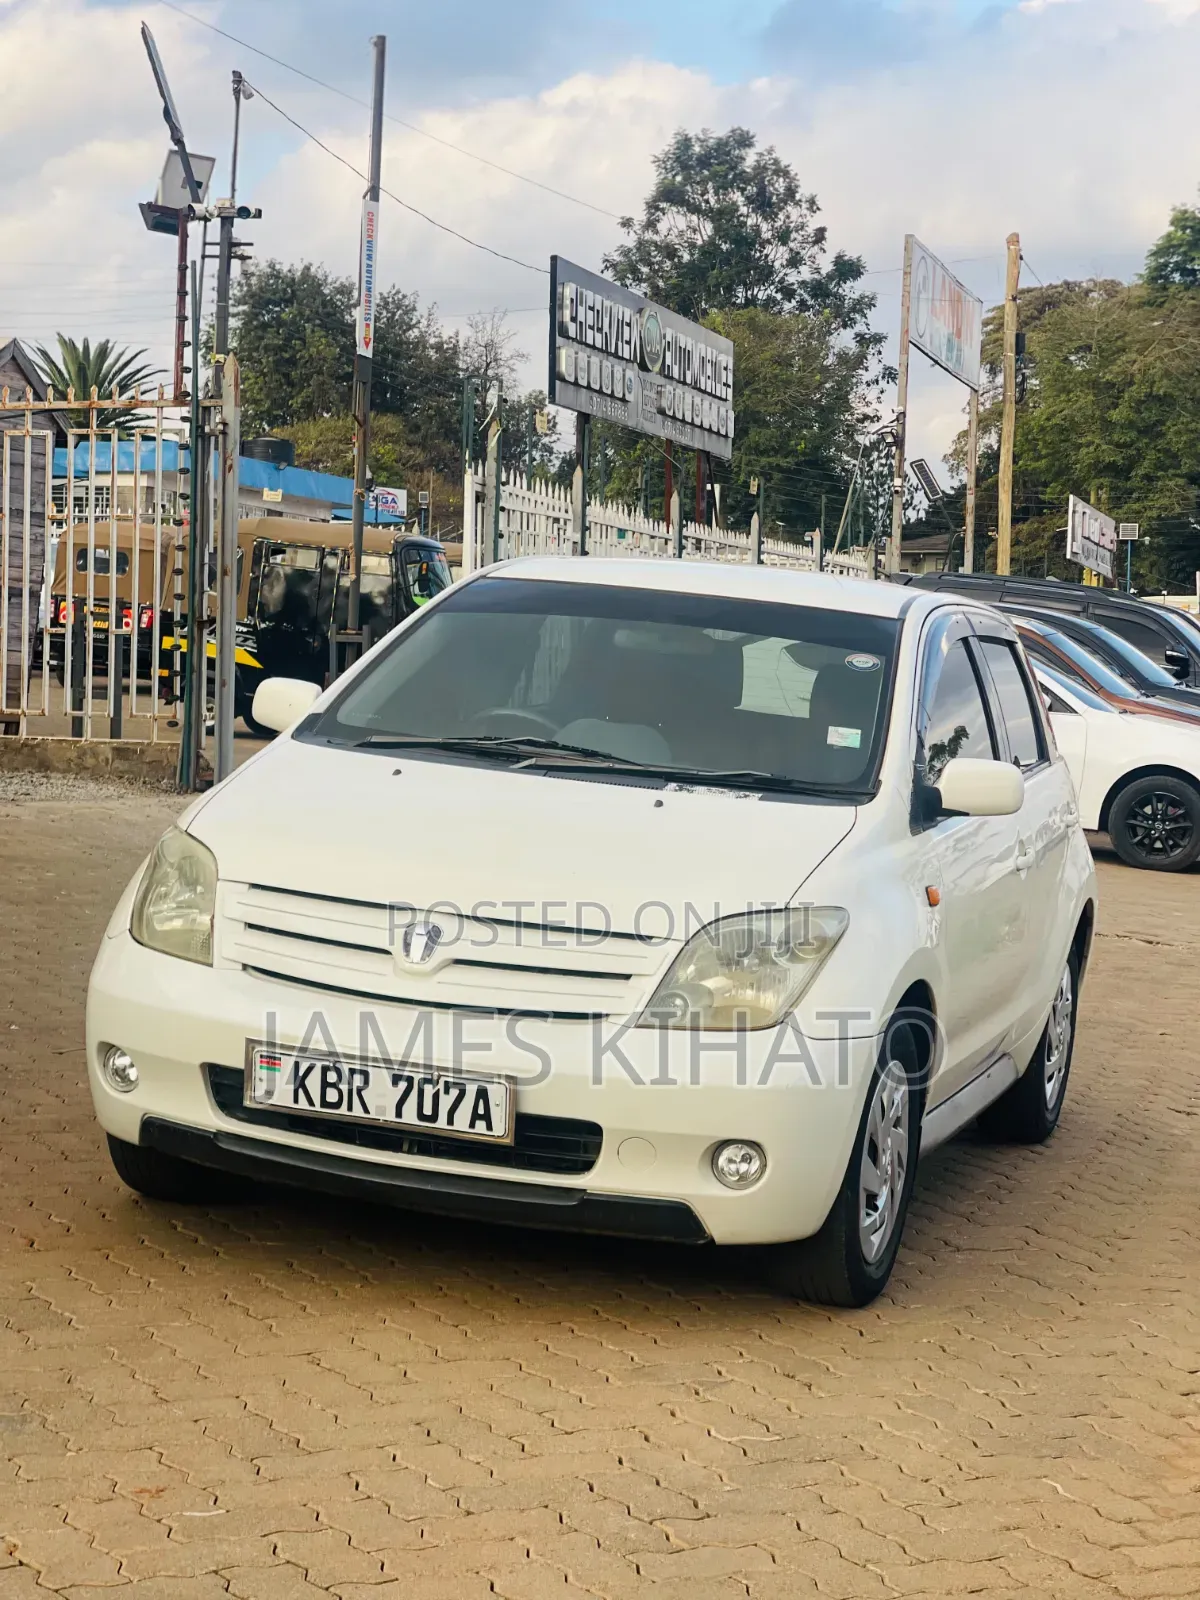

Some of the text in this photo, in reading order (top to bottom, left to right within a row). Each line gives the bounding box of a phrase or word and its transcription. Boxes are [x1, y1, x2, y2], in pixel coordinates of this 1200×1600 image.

[366, 211, 375, 262] CHECKVIEW
[364, 263, 373, 322] AUTOMOBILES
[559, 281, 640, 363] CHECKVIEW
[665, 327, 733, 401] AUTOMOBILES
[293, 1061, 493, 1132] KBR 707A
